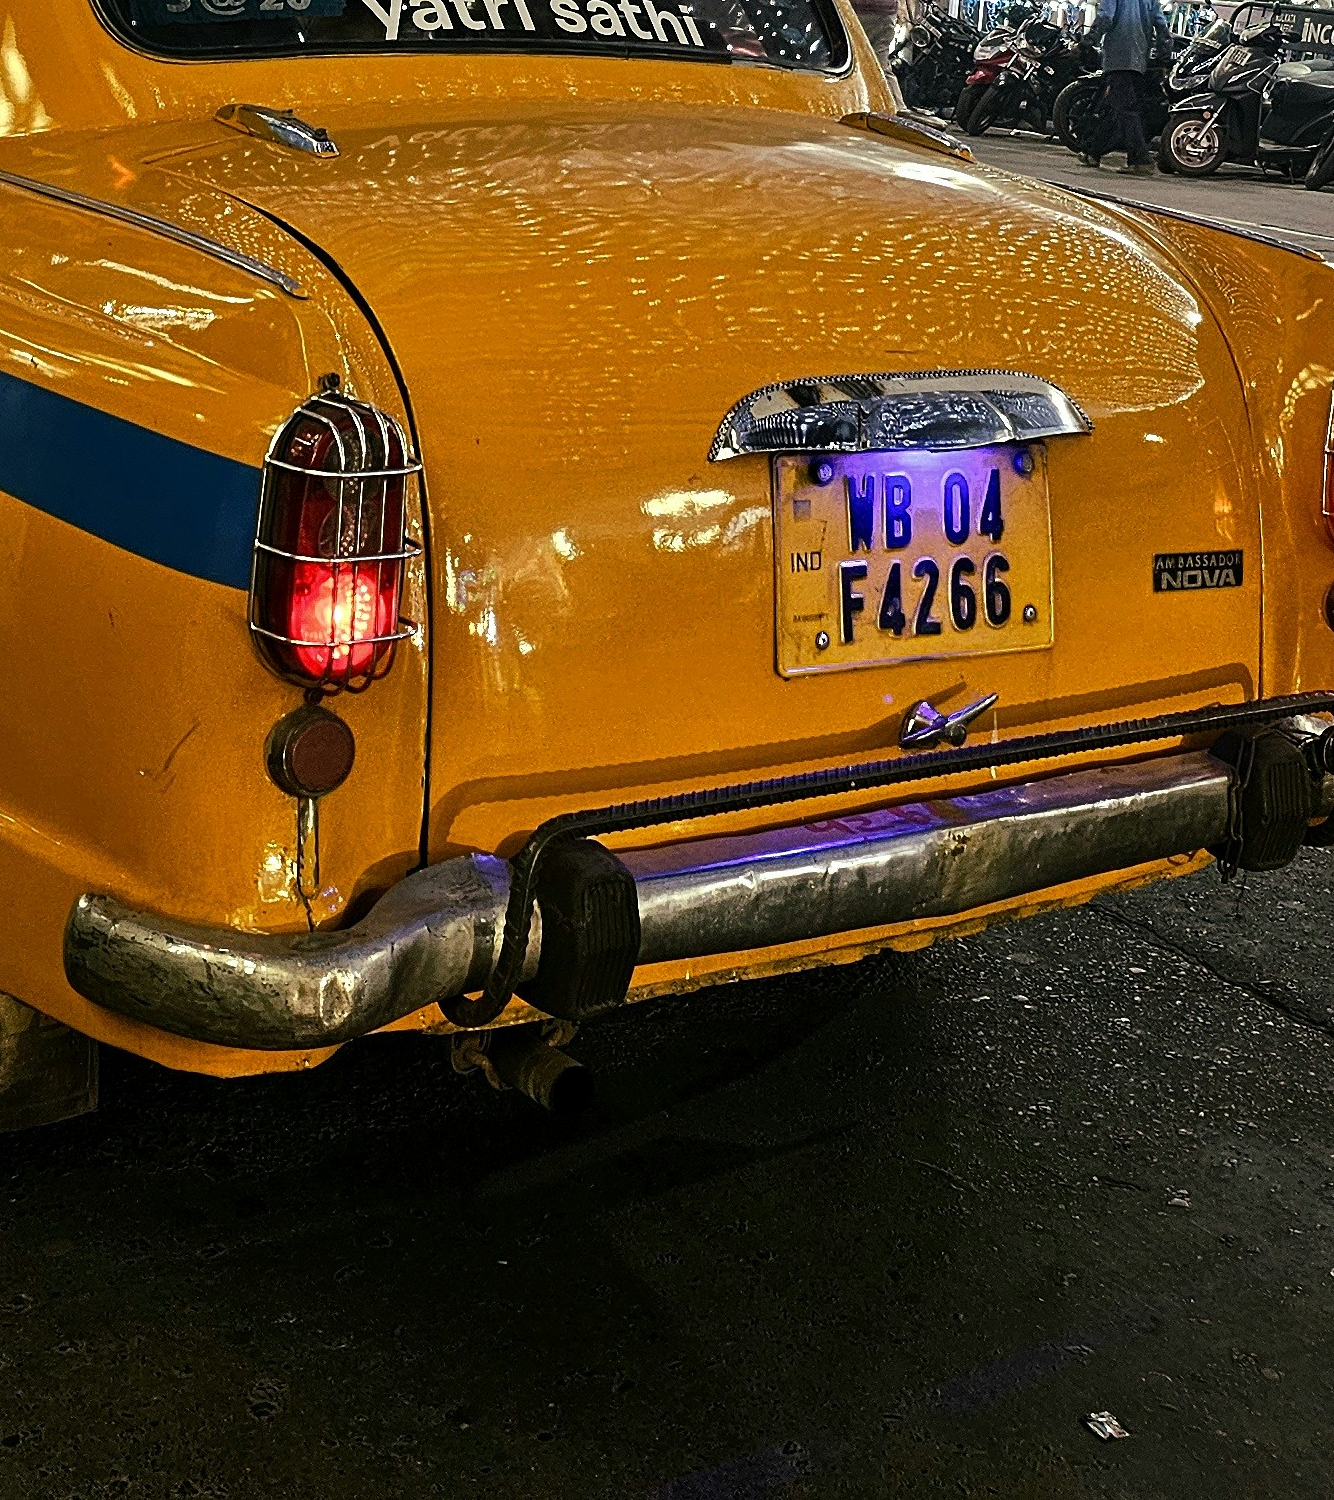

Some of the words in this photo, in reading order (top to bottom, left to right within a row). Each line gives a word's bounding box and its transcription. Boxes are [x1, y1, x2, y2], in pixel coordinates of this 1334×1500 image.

[844, 472, 913, 553] WB
[940, 467, 1005, 547] 04
[791, 551, 822, 573] IND
[1156, 553, 1241, 570] AMBASSADOR
[1161, 568, 1236, 590] NOVA
[838, 552, 1012, 644] F4266
